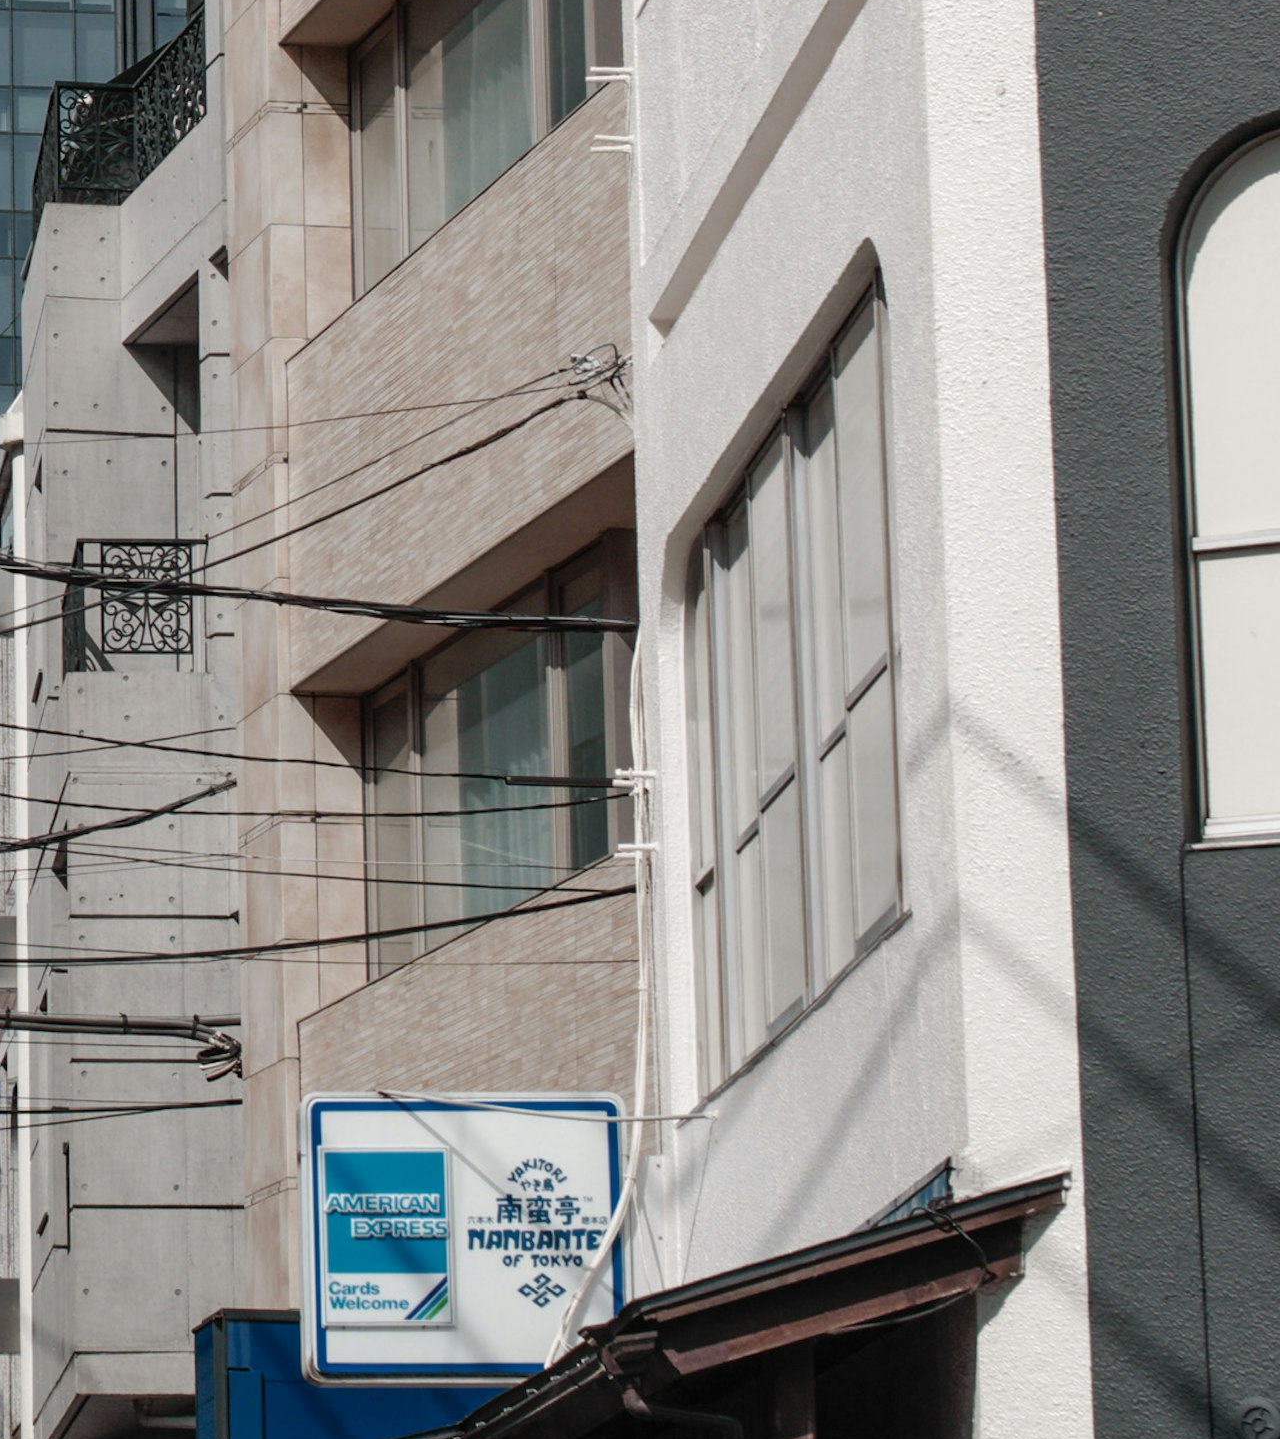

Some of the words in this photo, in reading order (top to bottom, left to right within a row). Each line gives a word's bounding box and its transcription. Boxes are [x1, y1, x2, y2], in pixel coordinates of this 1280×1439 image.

[507, 1157, 569, 1185] YAKITORI
[325, 1193, 441, 1215] AMERICAN
[496, 1194, 581, 1225] 南蛮亭
[351, 1218, 450, 1239] EXPRESS
[467, 1228, 608, 1252] NANBANTE
[502, 1254, 524, 1267] OF
[531, 1254, 584, 1267] TOKYO
[329, 1281, 380, 1296] Cards
[330, 1296, 410, 1311] Welcome
